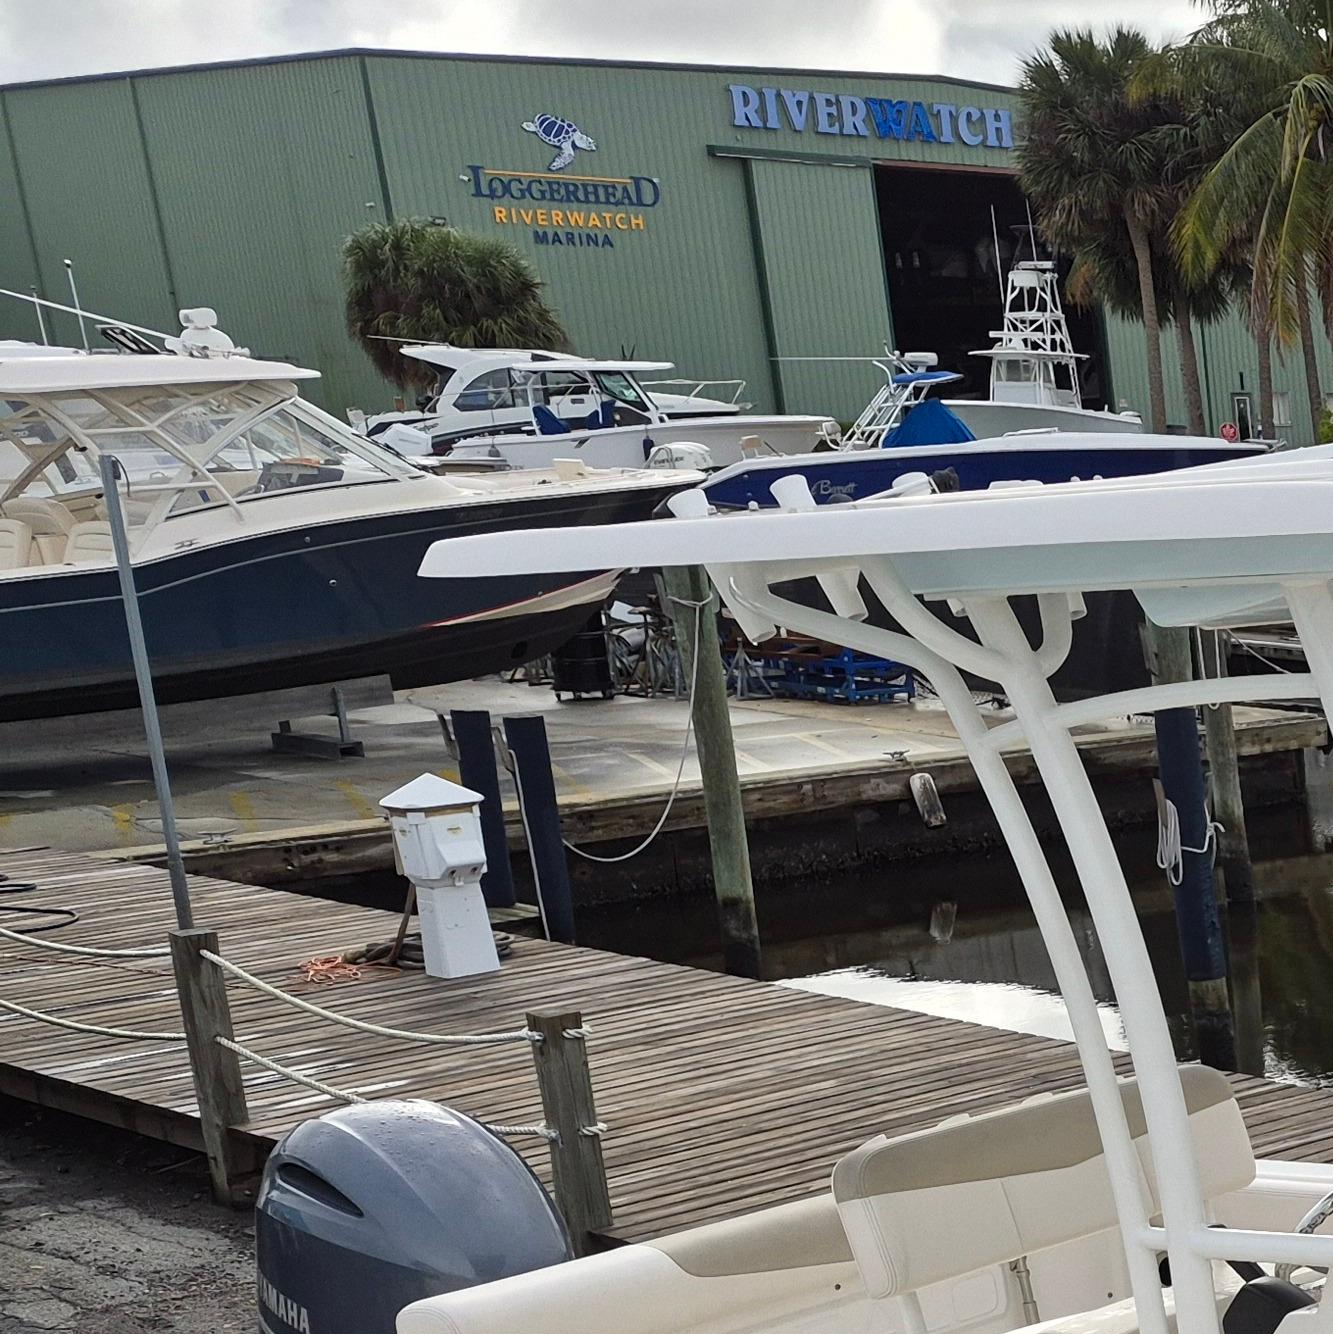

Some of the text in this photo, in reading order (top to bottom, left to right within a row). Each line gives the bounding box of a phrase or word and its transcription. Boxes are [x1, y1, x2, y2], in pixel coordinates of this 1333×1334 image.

[729, 84, 1014, 148] RIVERWATCH
[467, 165, 660, 208] LOGGERHEAD
[494, 206, 646, 230] RIVERWATCH
[533, 230, 614, 248] MARINA
